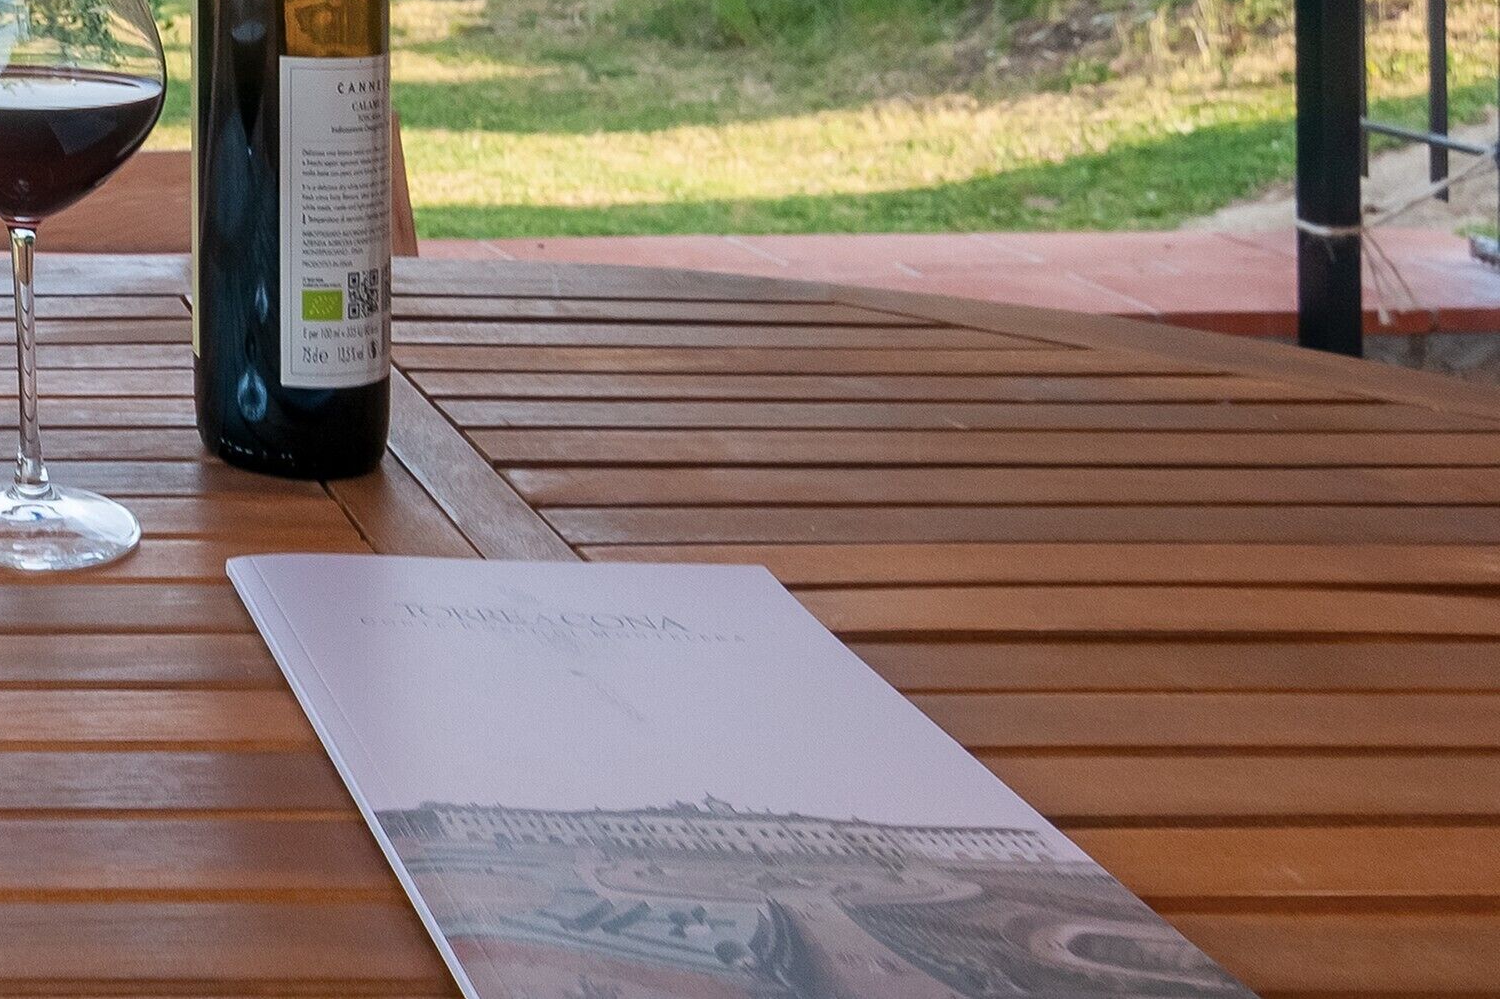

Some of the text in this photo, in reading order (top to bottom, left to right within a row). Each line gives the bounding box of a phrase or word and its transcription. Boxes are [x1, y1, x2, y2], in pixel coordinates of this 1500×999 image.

[337, 80, 388, 94] CANNE
[394, 601, 527, 625] TORRE
[559, 611, 690, 633] CONA
